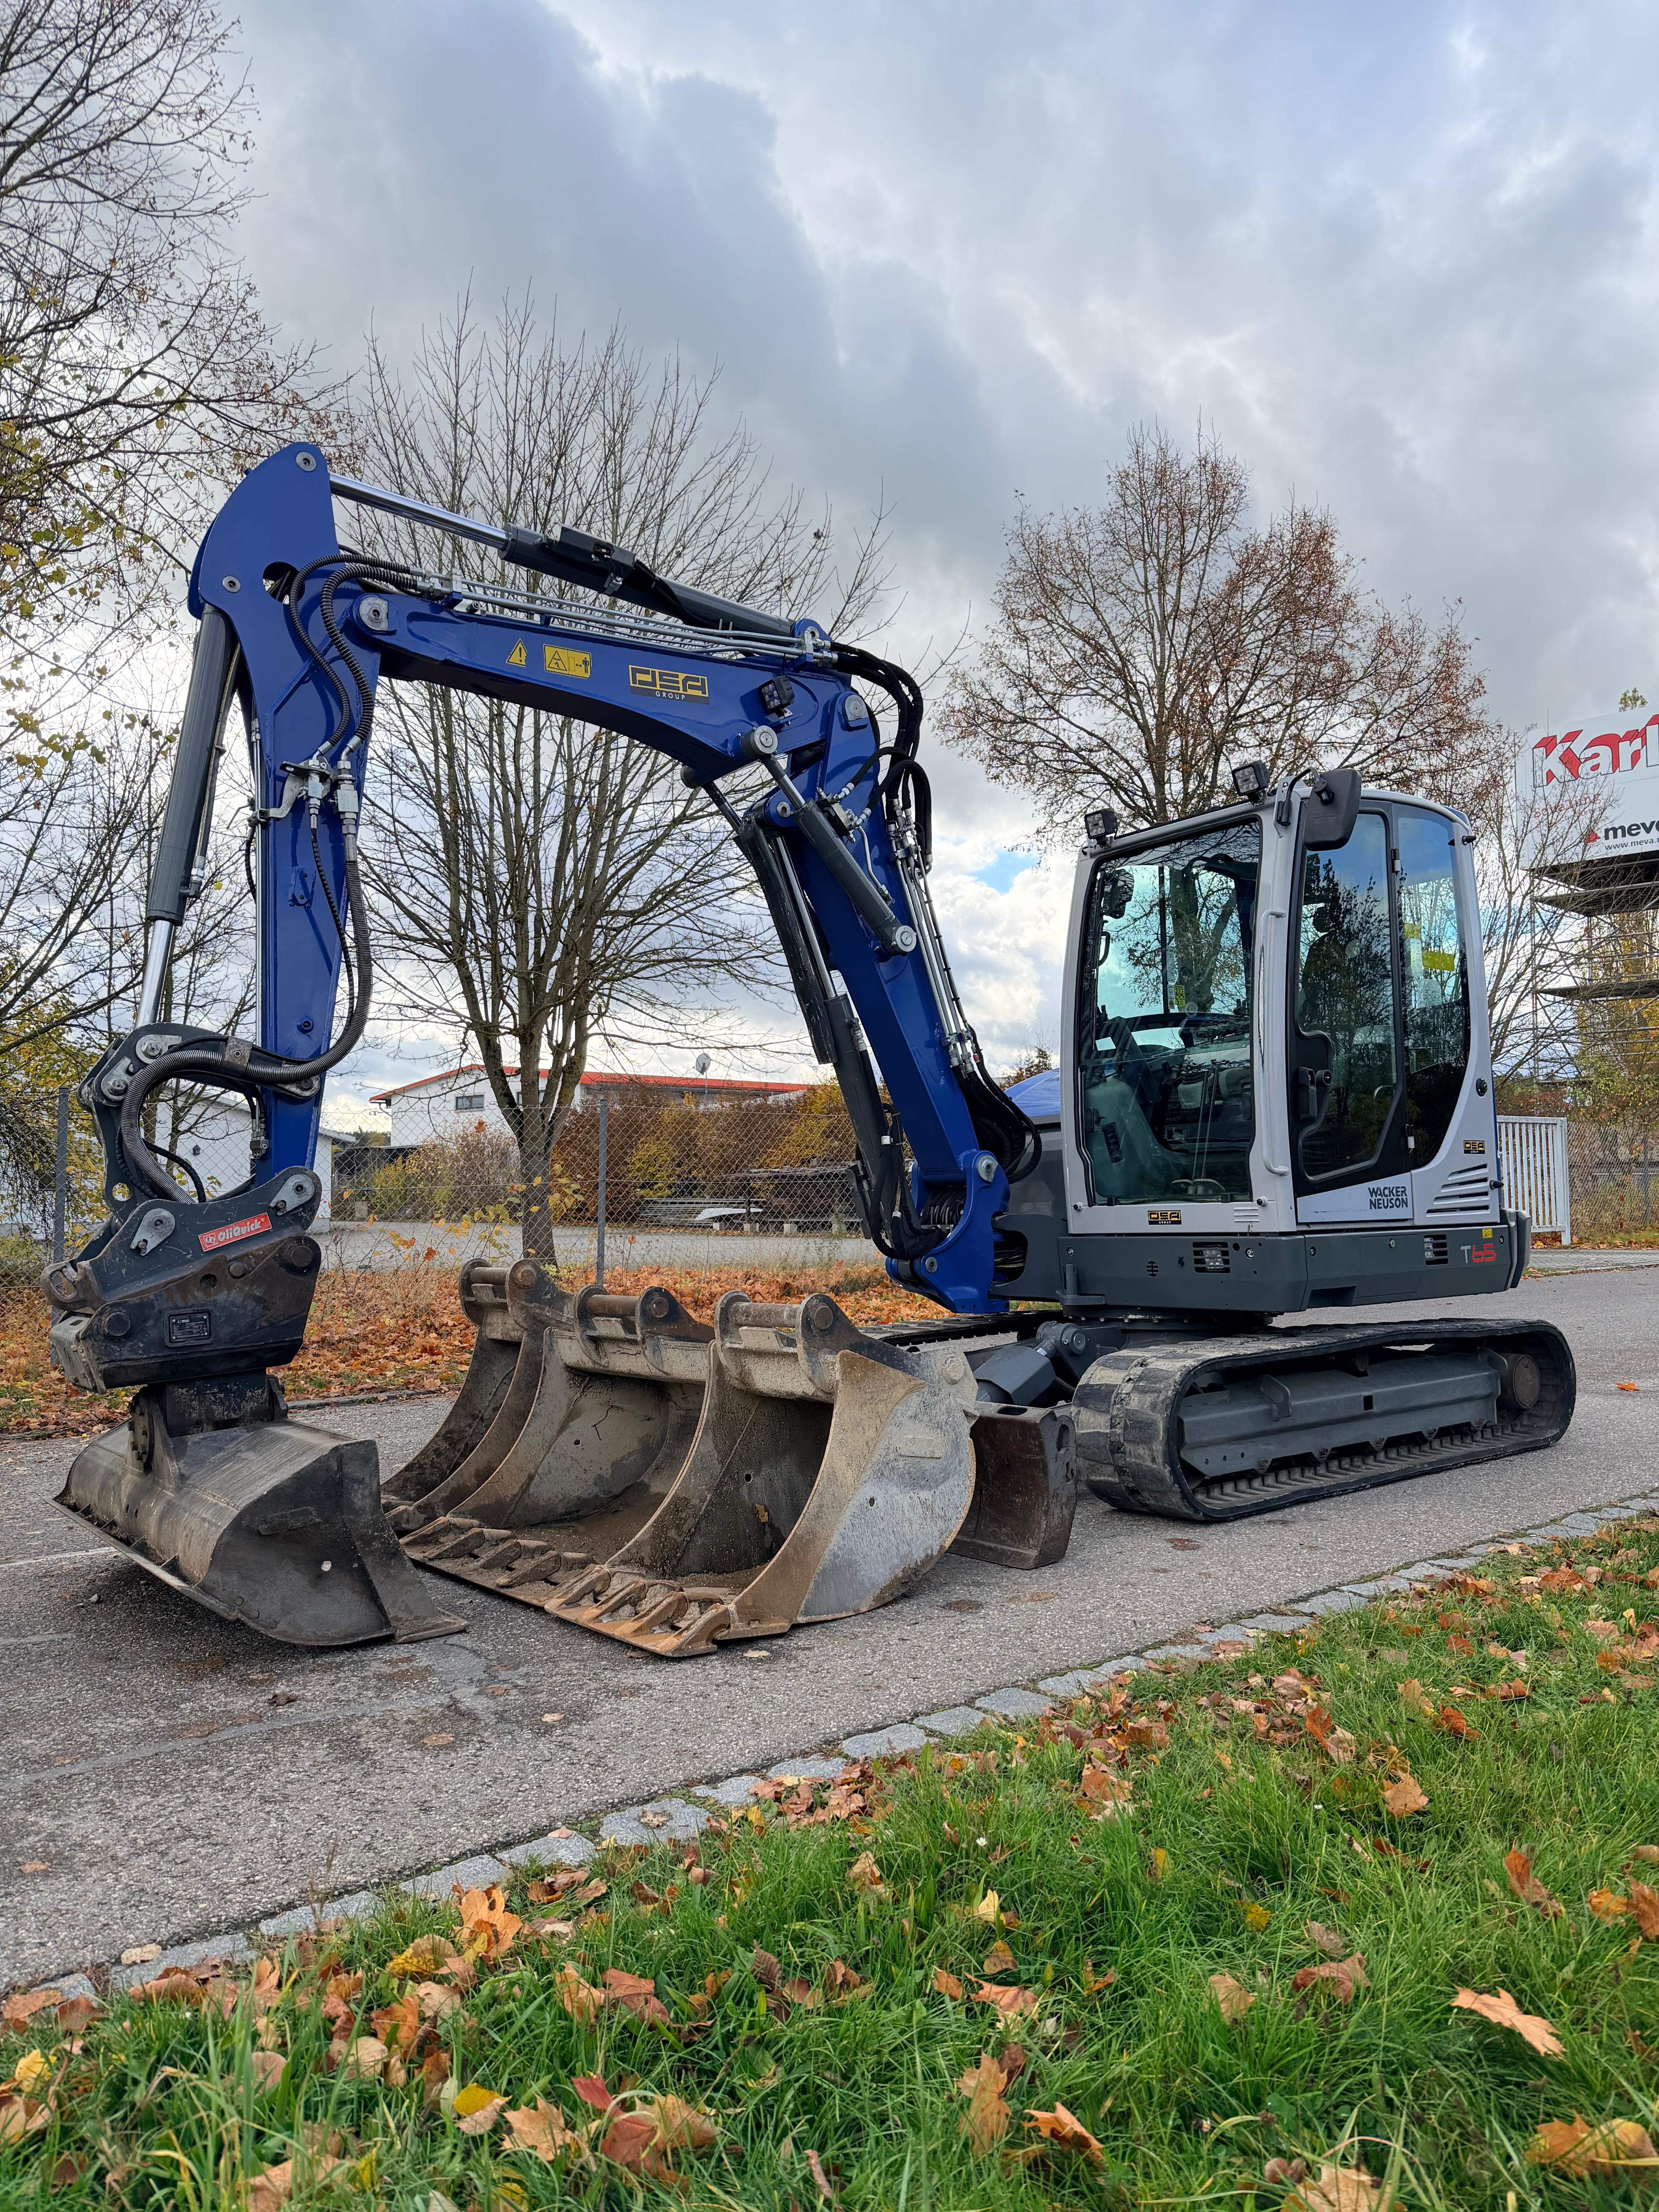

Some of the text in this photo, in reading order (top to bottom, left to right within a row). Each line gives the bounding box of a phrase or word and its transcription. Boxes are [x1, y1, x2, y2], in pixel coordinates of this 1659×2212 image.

[655, 691, 685, 700] GROUP
[1605, 838, 1659, 850] www.meva.
[1367, 1186, 1408, 1198] WACKER
[1369, 1197, 1408, 1210] NEUSON
[1460, 1243, 1497, 1263] T65
